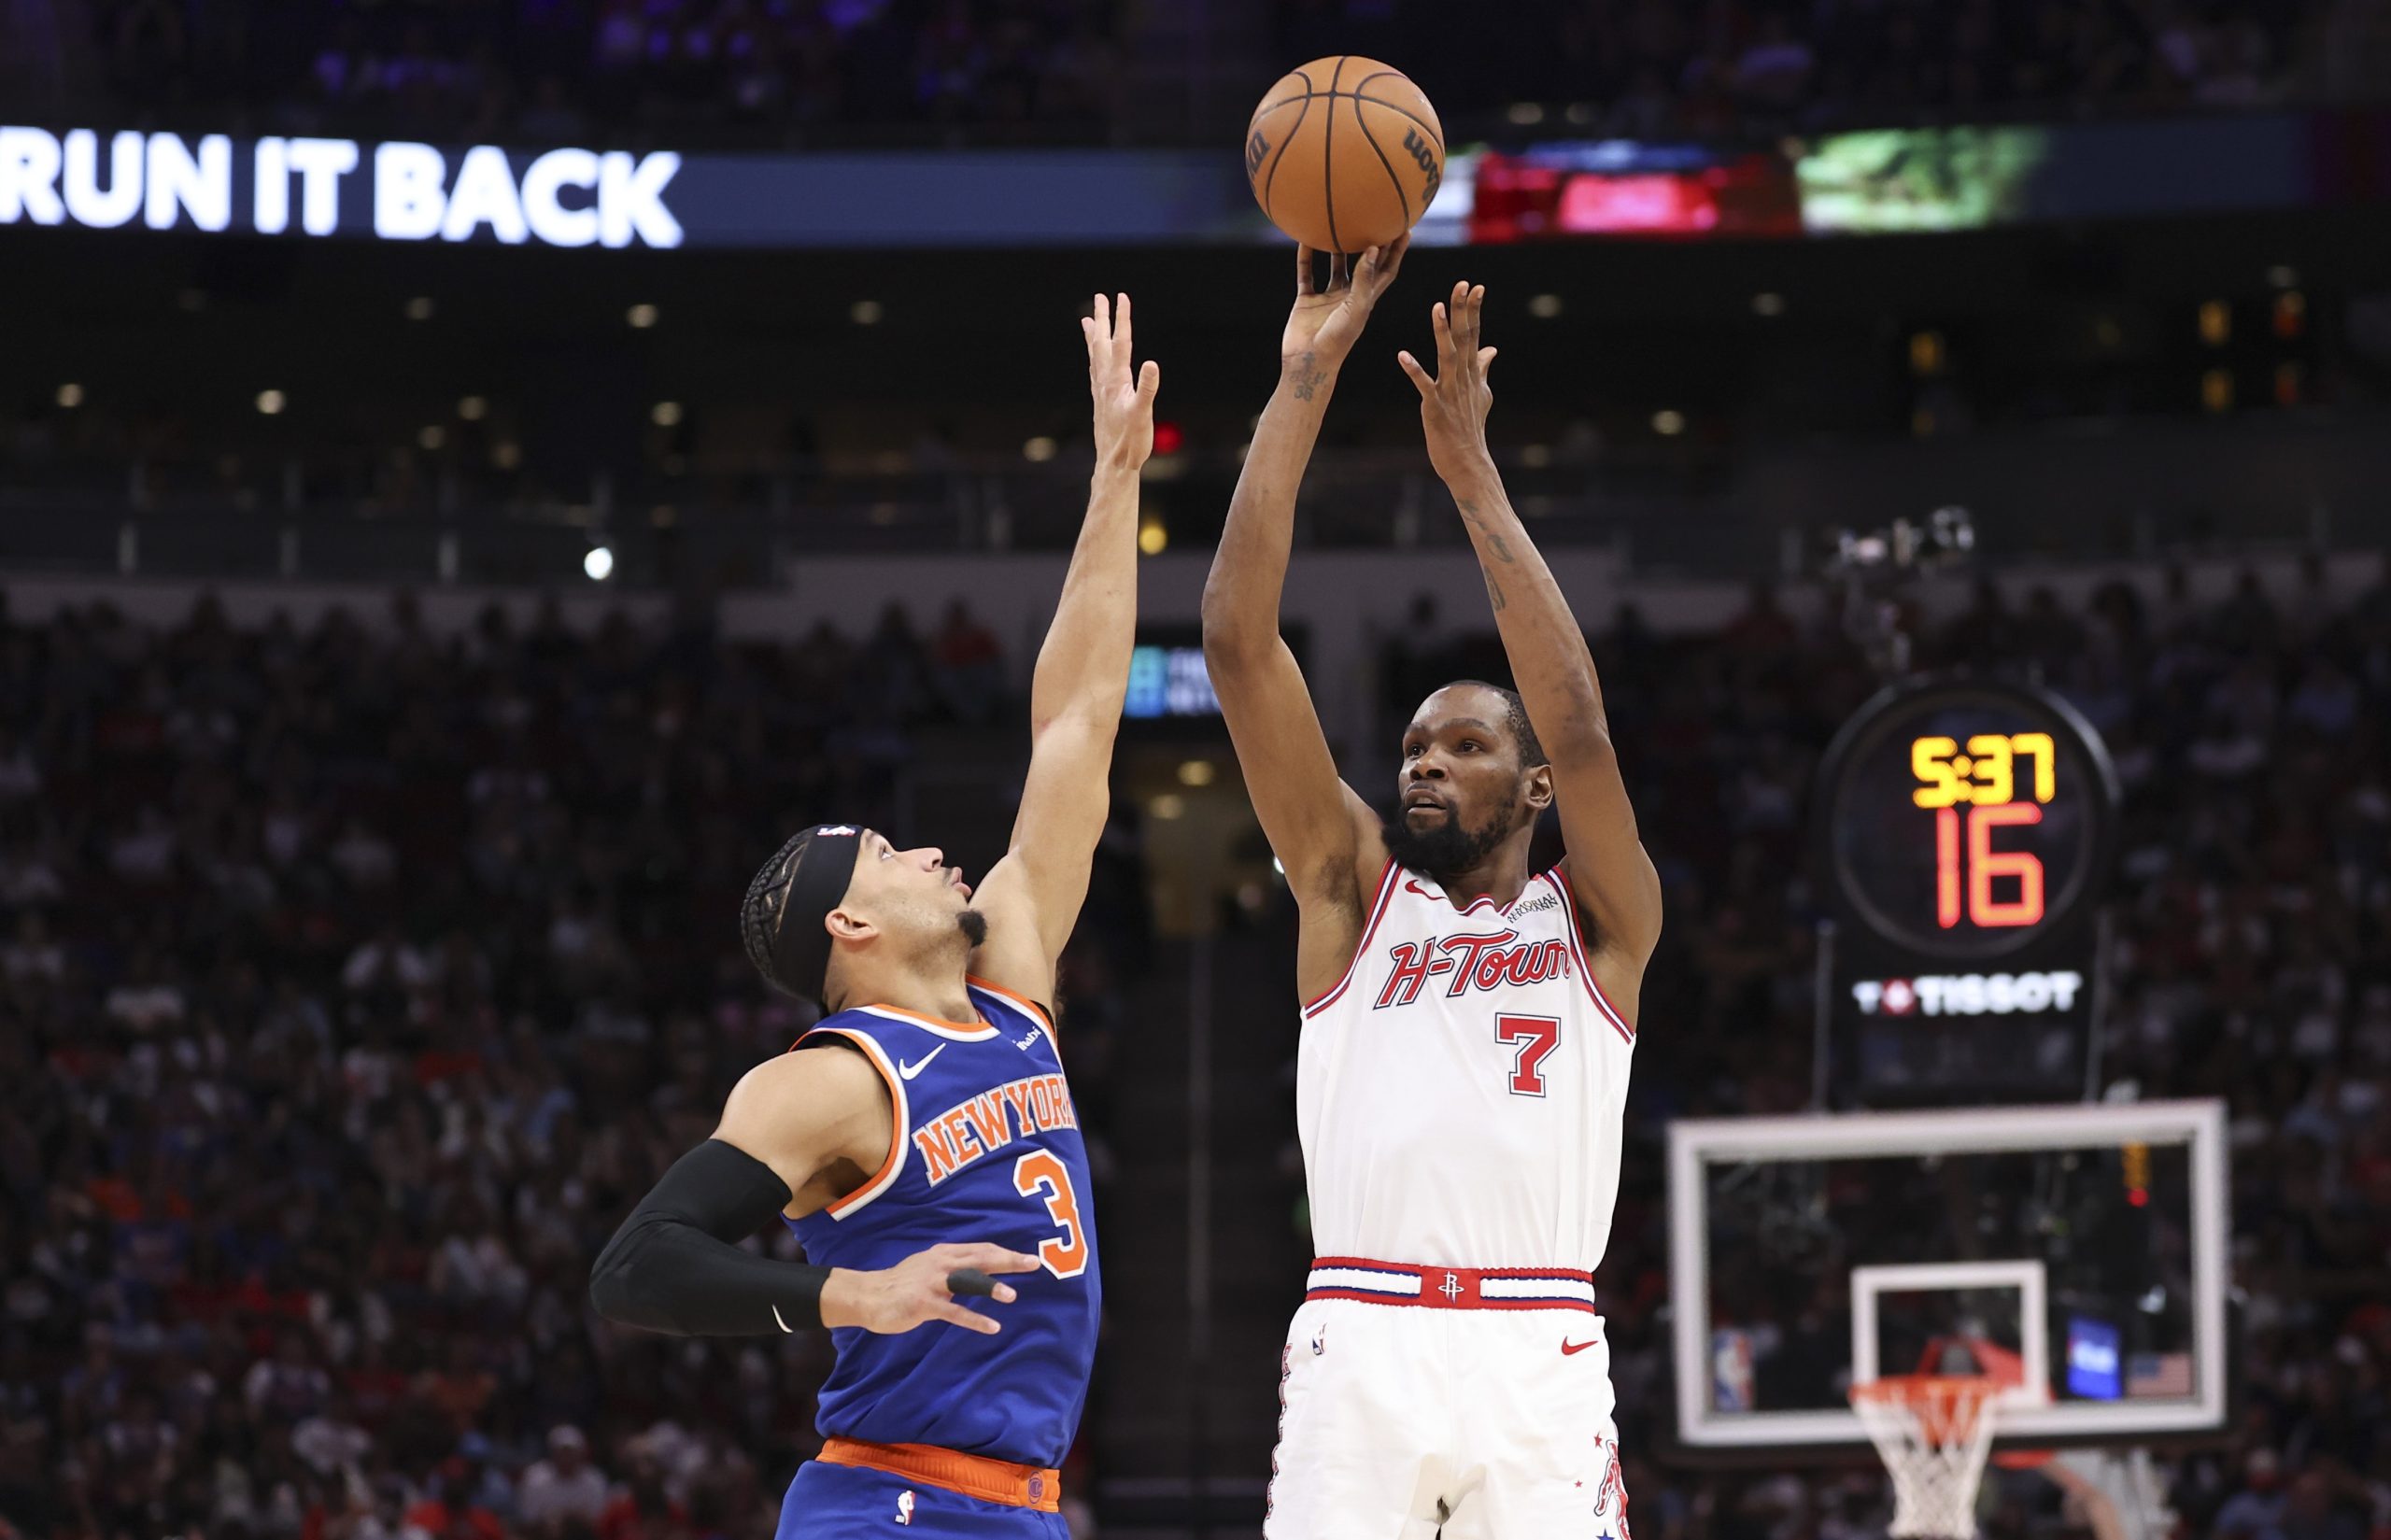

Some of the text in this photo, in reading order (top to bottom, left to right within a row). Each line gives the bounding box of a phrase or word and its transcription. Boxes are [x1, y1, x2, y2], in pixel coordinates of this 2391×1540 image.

[0, 126, 684, 248] RUN IT BACK
[1403, 125, 1440, 201] lson
[1912, 732, 2055, 809] 5:37
[1936, 800, 2044, 928] 16
[1373, 928, 1570, 1010] H-Town
[1915, 971, 2082, 1016] TISSOT
[1495, 1012, 1561, 1098] 7
[911, 1088, 1012, 1188] NEW
[1012, 1148, 1088, 1279] 3
